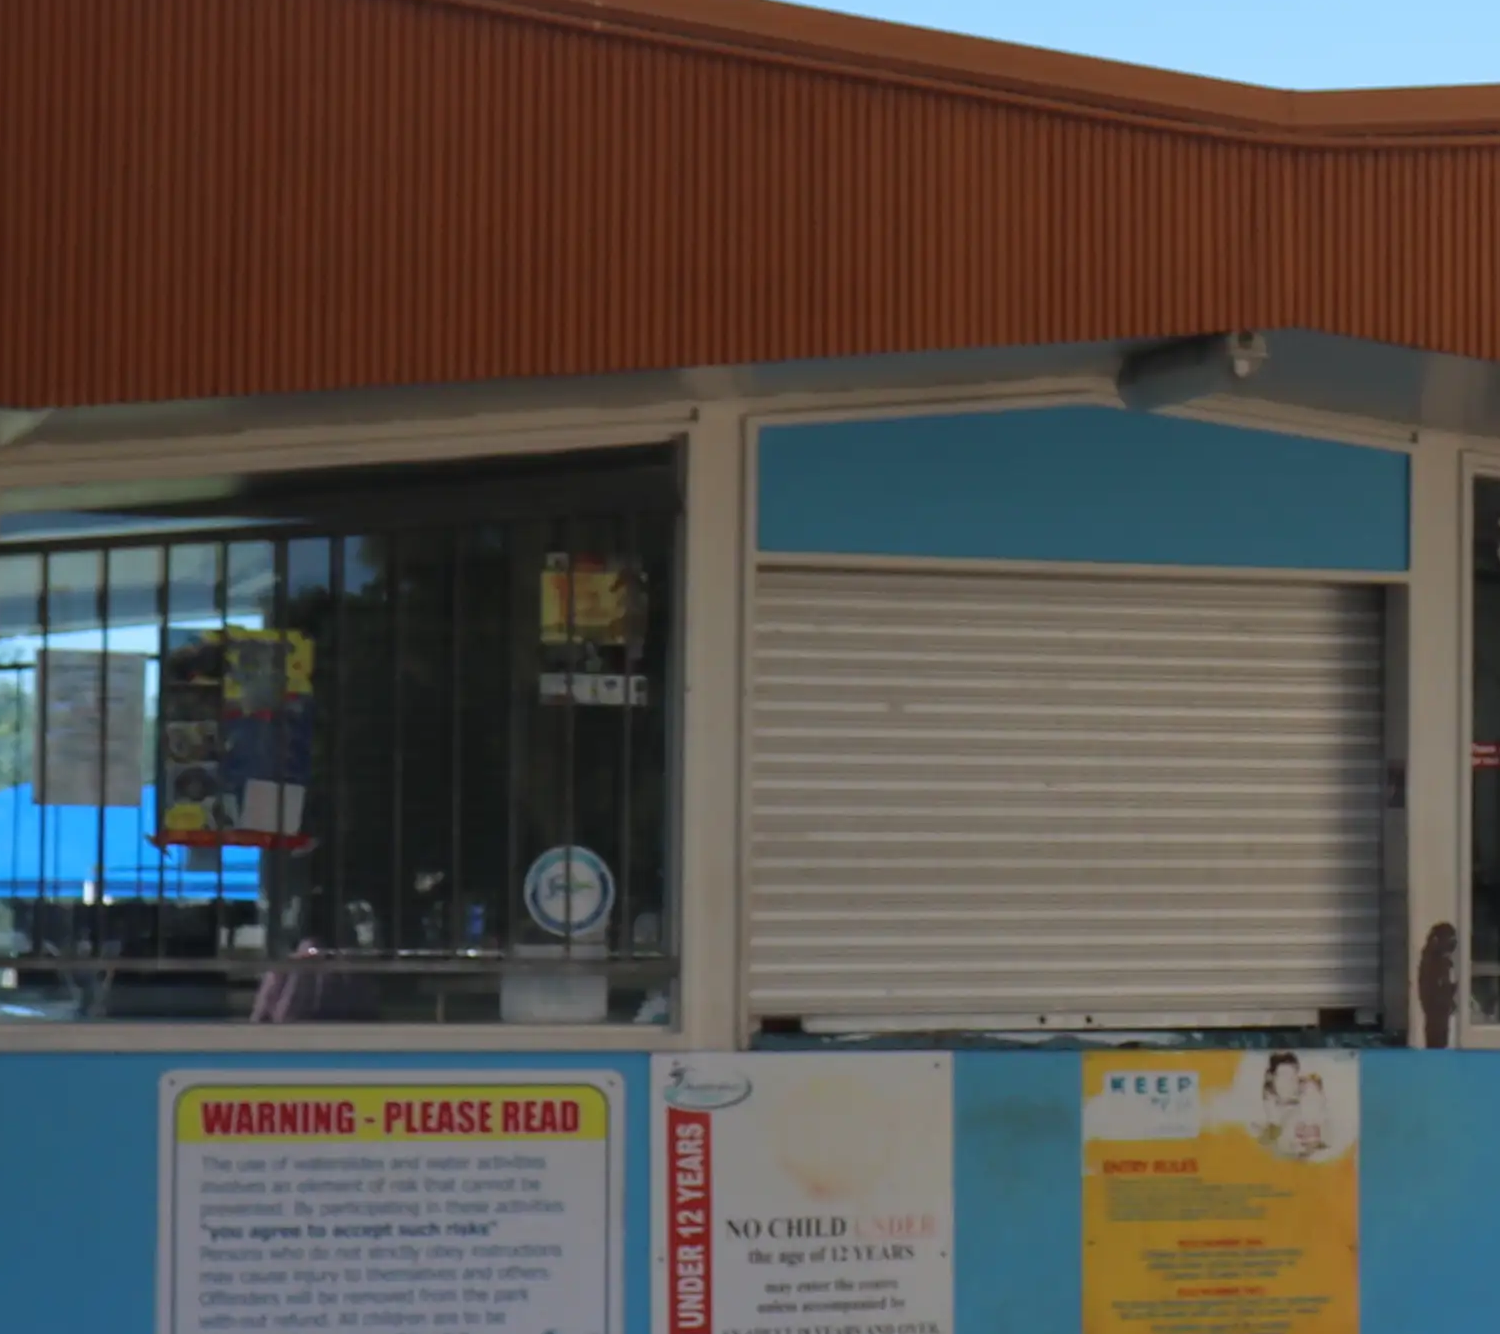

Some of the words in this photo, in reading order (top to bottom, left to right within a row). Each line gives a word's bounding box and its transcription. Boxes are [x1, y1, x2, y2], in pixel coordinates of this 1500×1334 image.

[1110, 1075, 1193, 1095] KEEP
[202, 1101, 356, 1135] WARNING
[383, 1101, 493, 1134] PLEASE
[501, 1100, 580, 1134] READ
[675, 1123, 705, 1203] YEARS
[249, 1226, 302, 1242] agree
[307, 1224, 327, 1238] to
[332, 1224, 393, 1240] accept
[398, 1222, 441, 1237] such
[676, 1210, 704, 1239] 12
[726, 1218, 763, 1240] NO
[767, 1217, 847, 1239] CHILD
[853, 1244, 916, 1261] YEARS
[676, 1244, 705, 1328] UNDER
